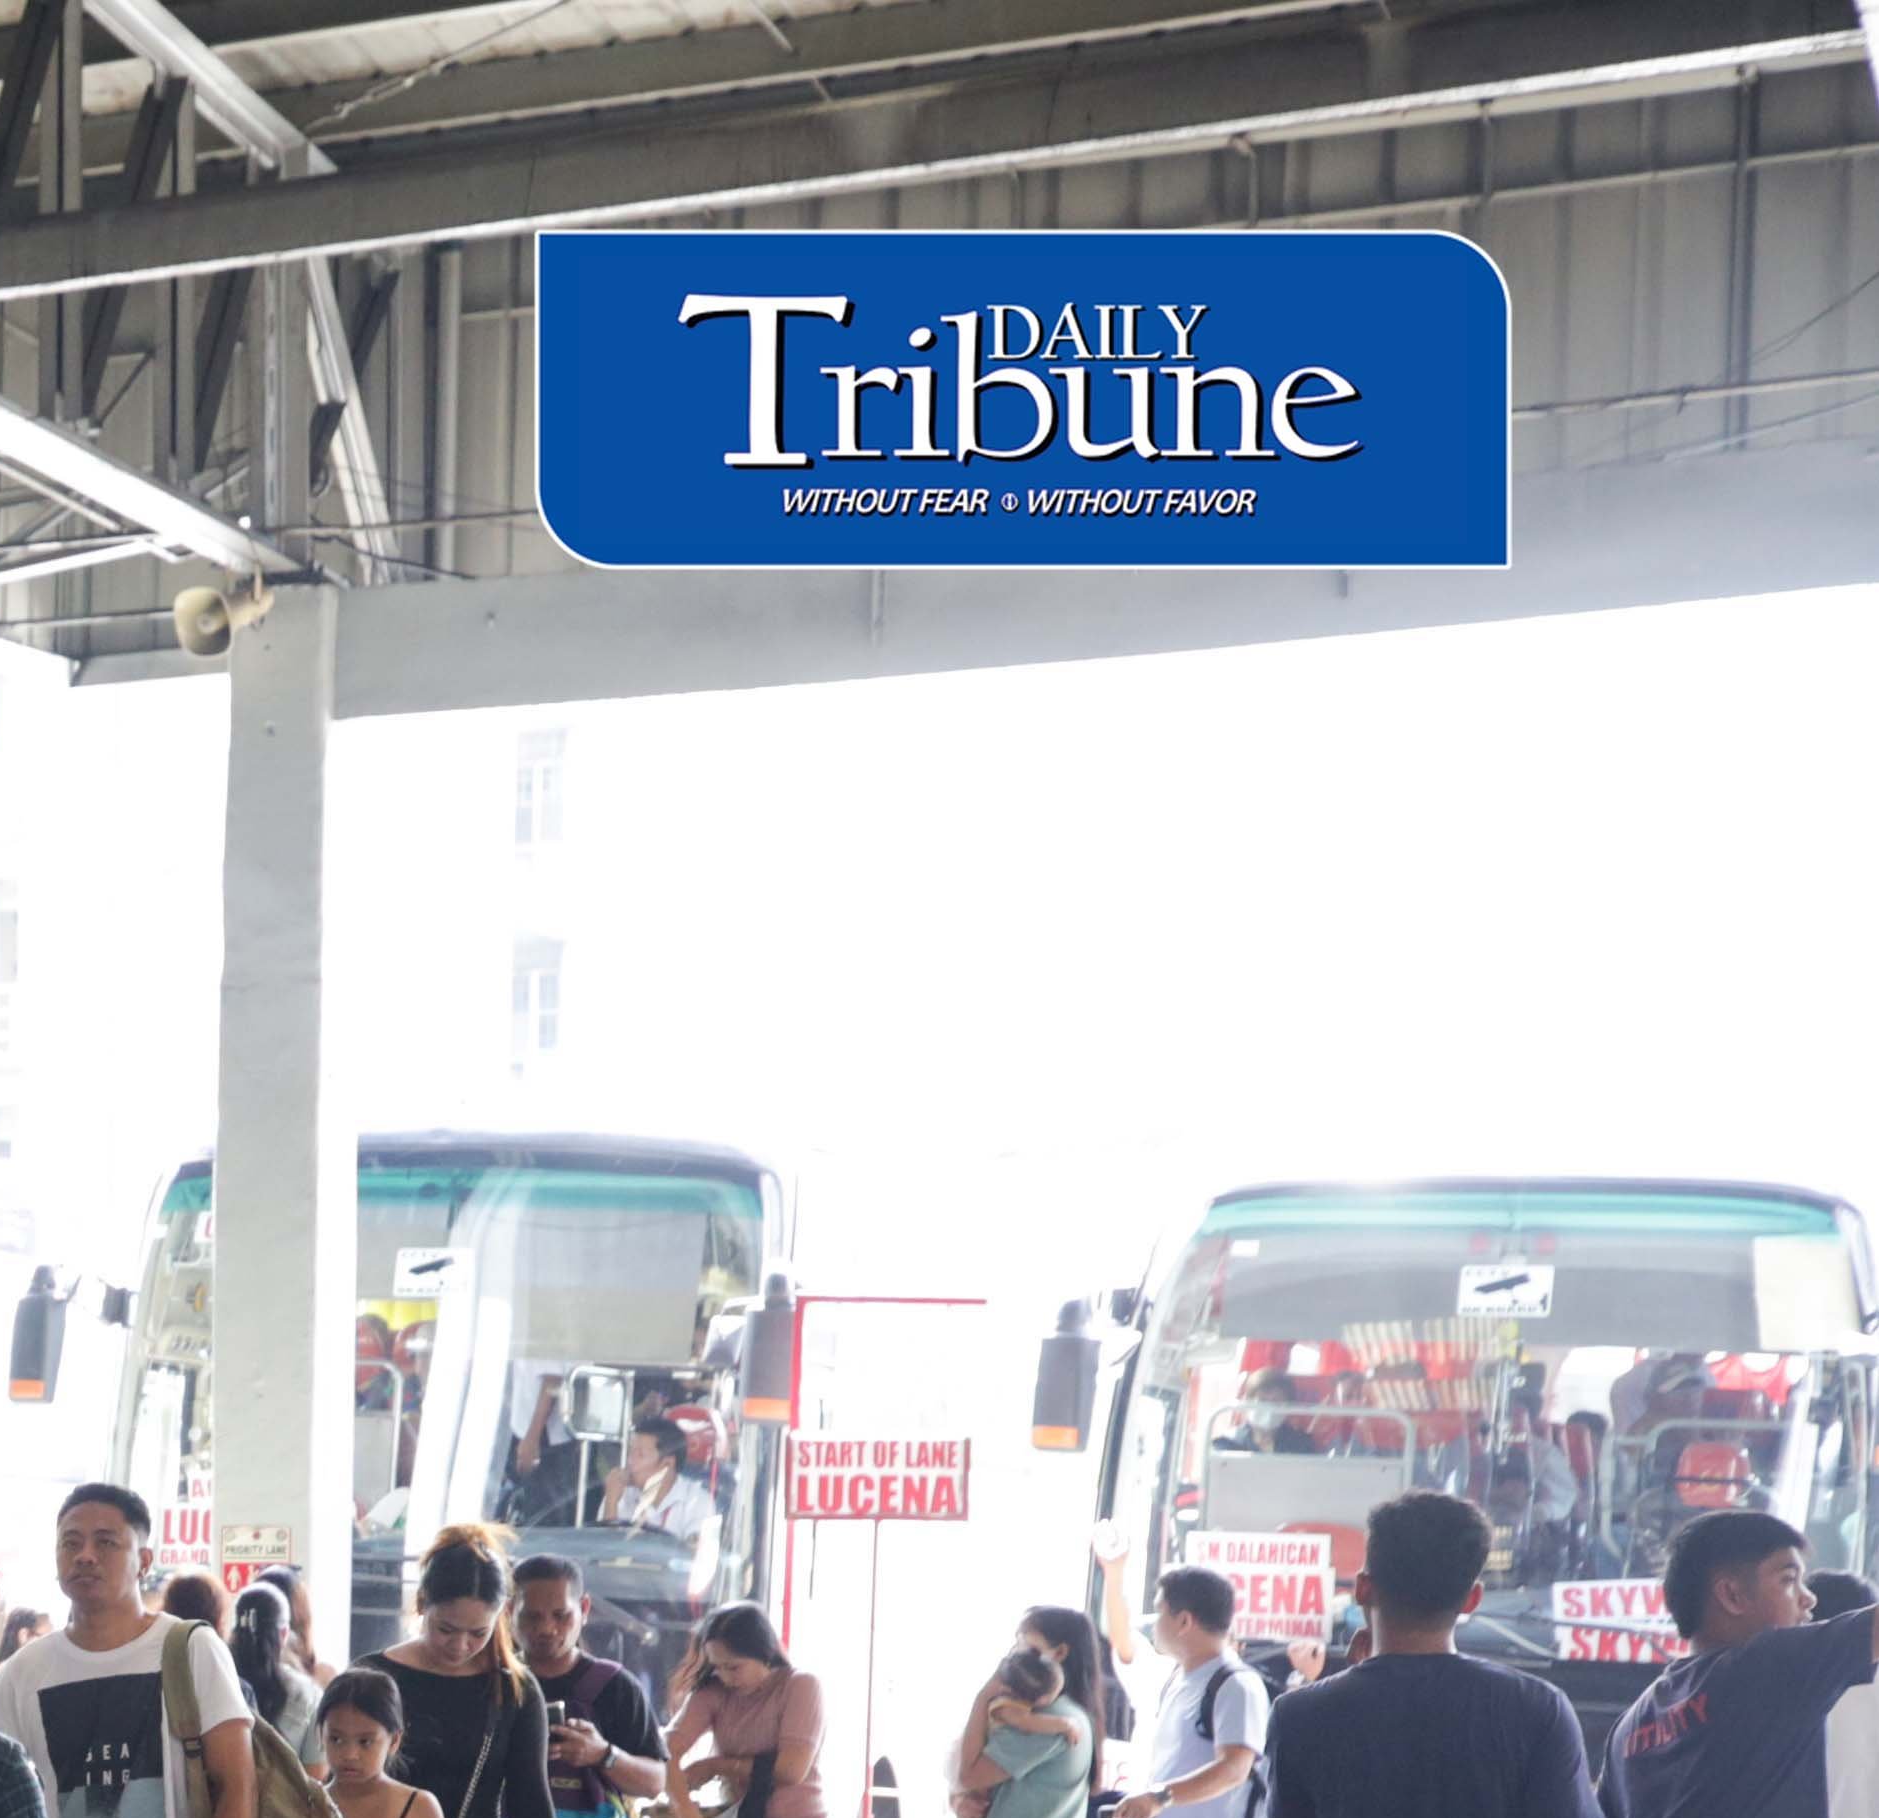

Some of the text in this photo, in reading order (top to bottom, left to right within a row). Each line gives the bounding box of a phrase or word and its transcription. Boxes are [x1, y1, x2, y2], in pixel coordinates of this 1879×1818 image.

[797, 1440, 957, 1469] START OF LANE
[796, 1474, 957, 1517] LUCENA
[224, 1543, 287, 1555] PRIORITY LANE
[1229, 1573, 1325, 1615] CENA
[1236, 1616, 1324, 1638] TERMINAL
